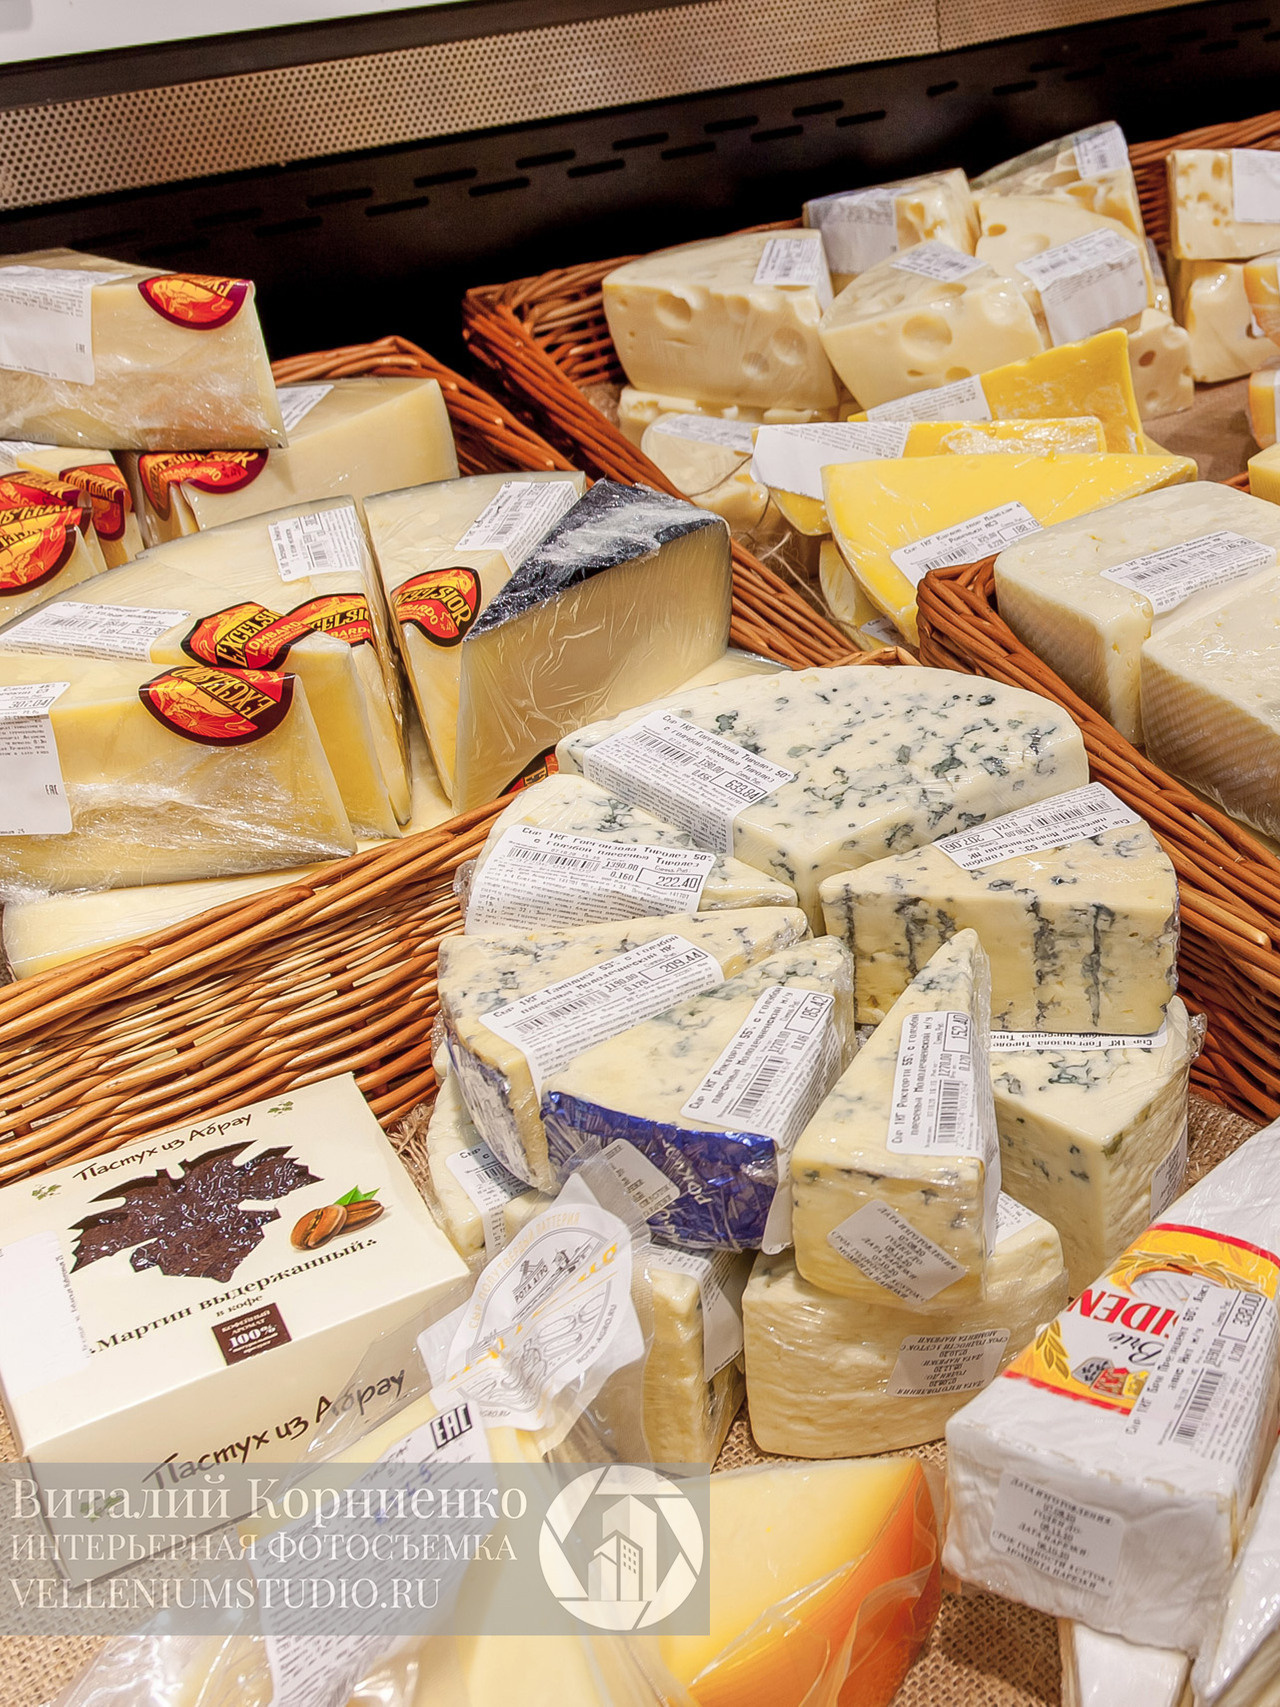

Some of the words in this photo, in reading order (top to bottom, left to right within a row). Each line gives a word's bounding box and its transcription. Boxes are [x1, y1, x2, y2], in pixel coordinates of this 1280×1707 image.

[724, 778, 761, 800] 633.84
[943, 833, 985, 852] 207.06
[654, 875, 698, 888] 222.40
[659, 951, 701, 973] 209.44
[799, 995, 829, 1022] 185.42
[951, 1014, 969, 1039] 152.40
[72, 1146, 158, 1182] Пастух
[161, 1138, 186, 1155] из
[189, 1113, 253, 1142] Абрау
[97, 1307, 194, 1352] Мартин
[199, 1238, 366, 1314] выдержанный
[227, 1294, 264, 1316] кофе
[229, 1324, 278, 1349] 100%
[142, 1430, 270, 1491] Пастух
[275, 1415, 310, 1442] из
